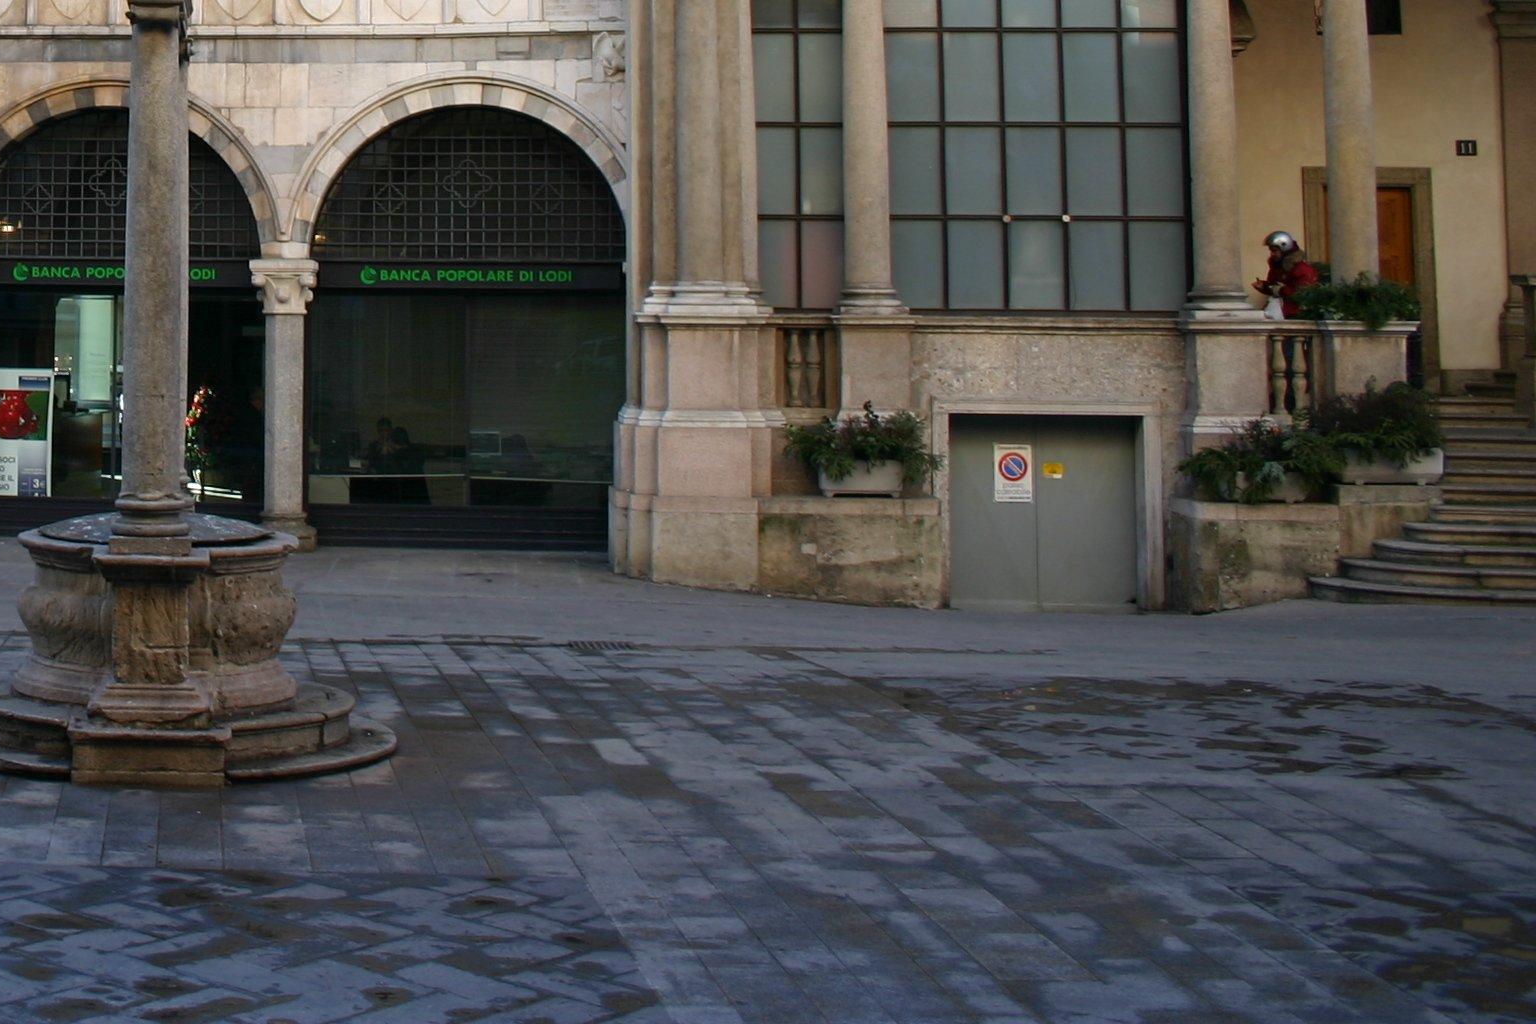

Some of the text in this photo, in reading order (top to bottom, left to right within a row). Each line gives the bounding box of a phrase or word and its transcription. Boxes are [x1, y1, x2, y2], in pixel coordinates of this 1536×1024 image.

[31, 265, 216, 280] BANCA POPO ODI
[379, 269, 573, 282] BANCA POPOLARE DI LODI
